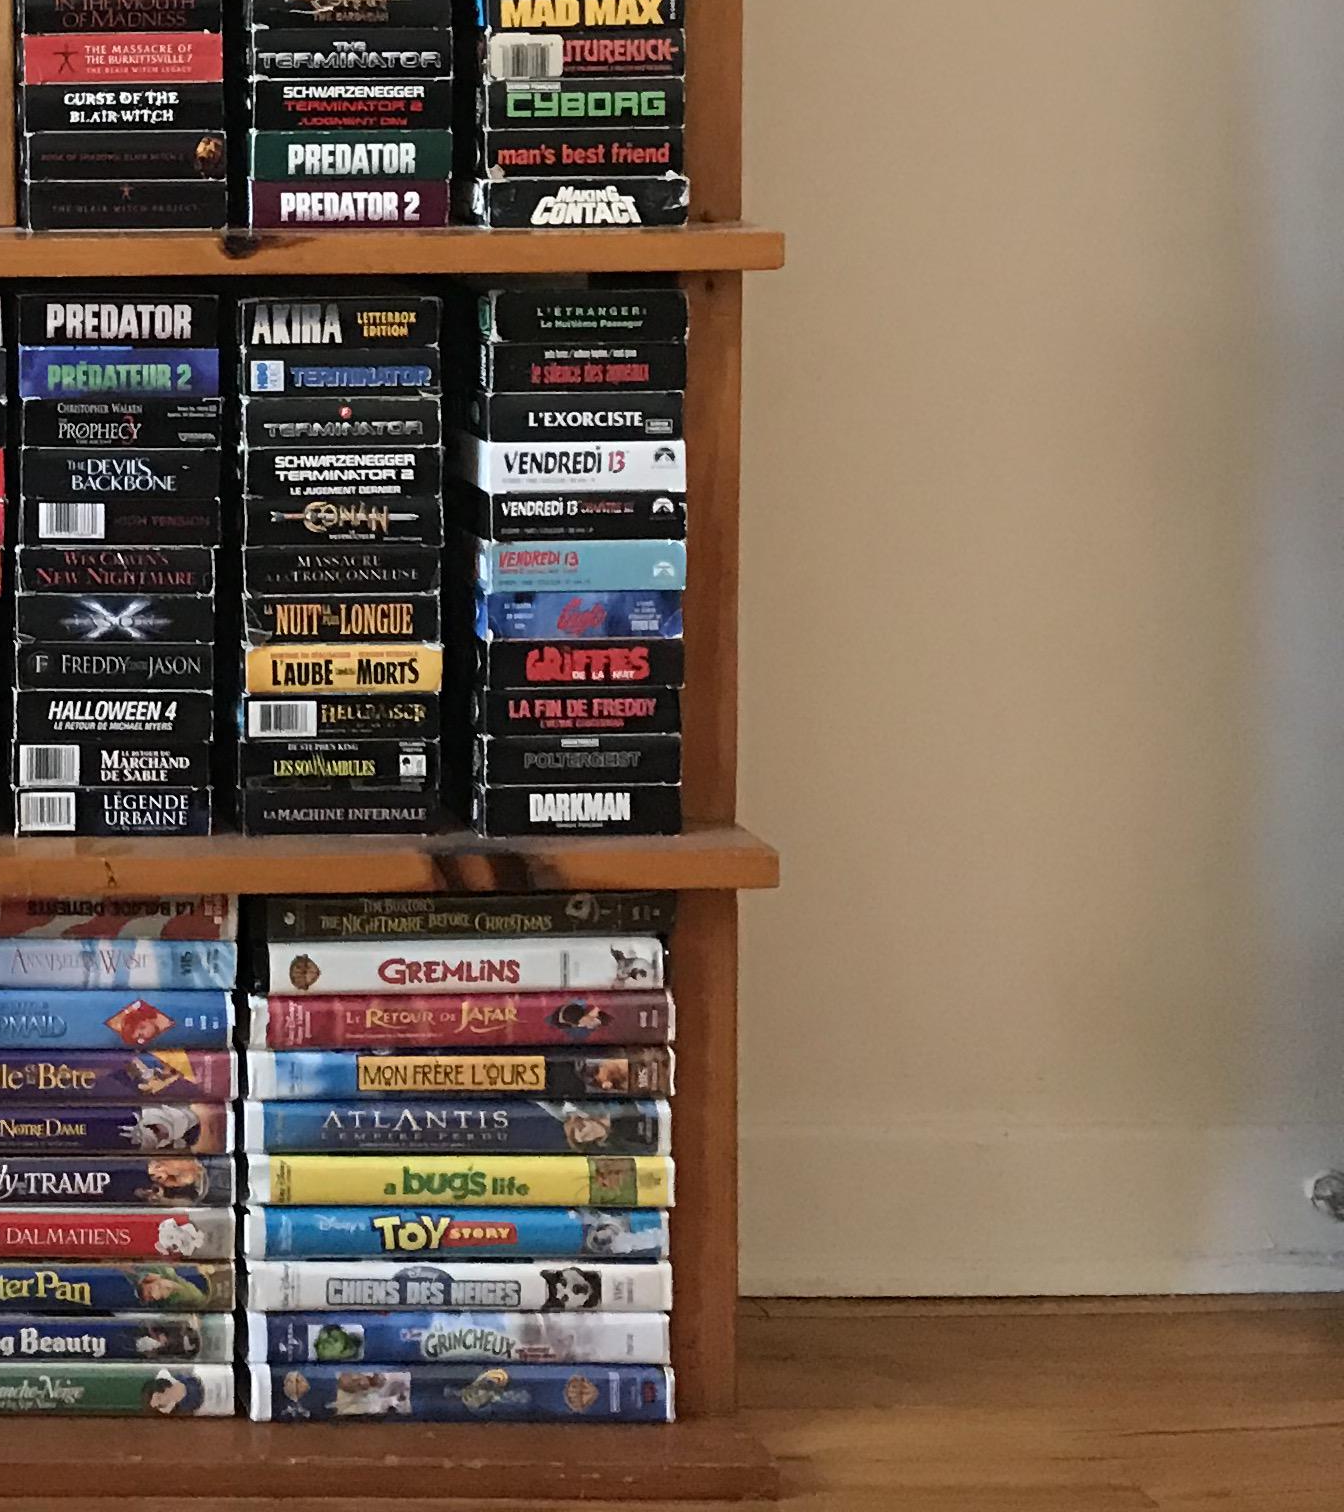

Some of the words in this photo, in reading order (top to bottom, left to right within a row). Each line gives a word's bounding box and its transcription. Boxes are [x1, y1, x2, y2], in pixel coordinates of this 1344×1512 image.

[507, 91, 666, 118] CYBORG
[287, 143, 415, 175] PREDATOR
[498, 145, 553, 166] man's
[562, 142, 605, 164] best
[611, 142, 669, 165] friend
[46, 305, 192, 339] PREDATOR
[251, 304, 342, 343] AKIRA
[357, 312, 416, 324] LETTERBOX
[363, 324, 409, 336] EDITION
[527, 411, 643, 428] L'EXORCISTE
[362, 1064, 407, 1086] MON
[413, 1061, 463, 1086] FRÈRE
[467, 1063, 540, 1086] L'OURS
[322, 1110, 508, 1128] ATLANTIS
[384, 1182, 396, 1195] a
[401, 1167, 485, 1198] bug's
[492, 1179, 529, 1196] life
[373, 1216, 451, 1253] TOY
[449, 1226, 511, 1241] STORY
